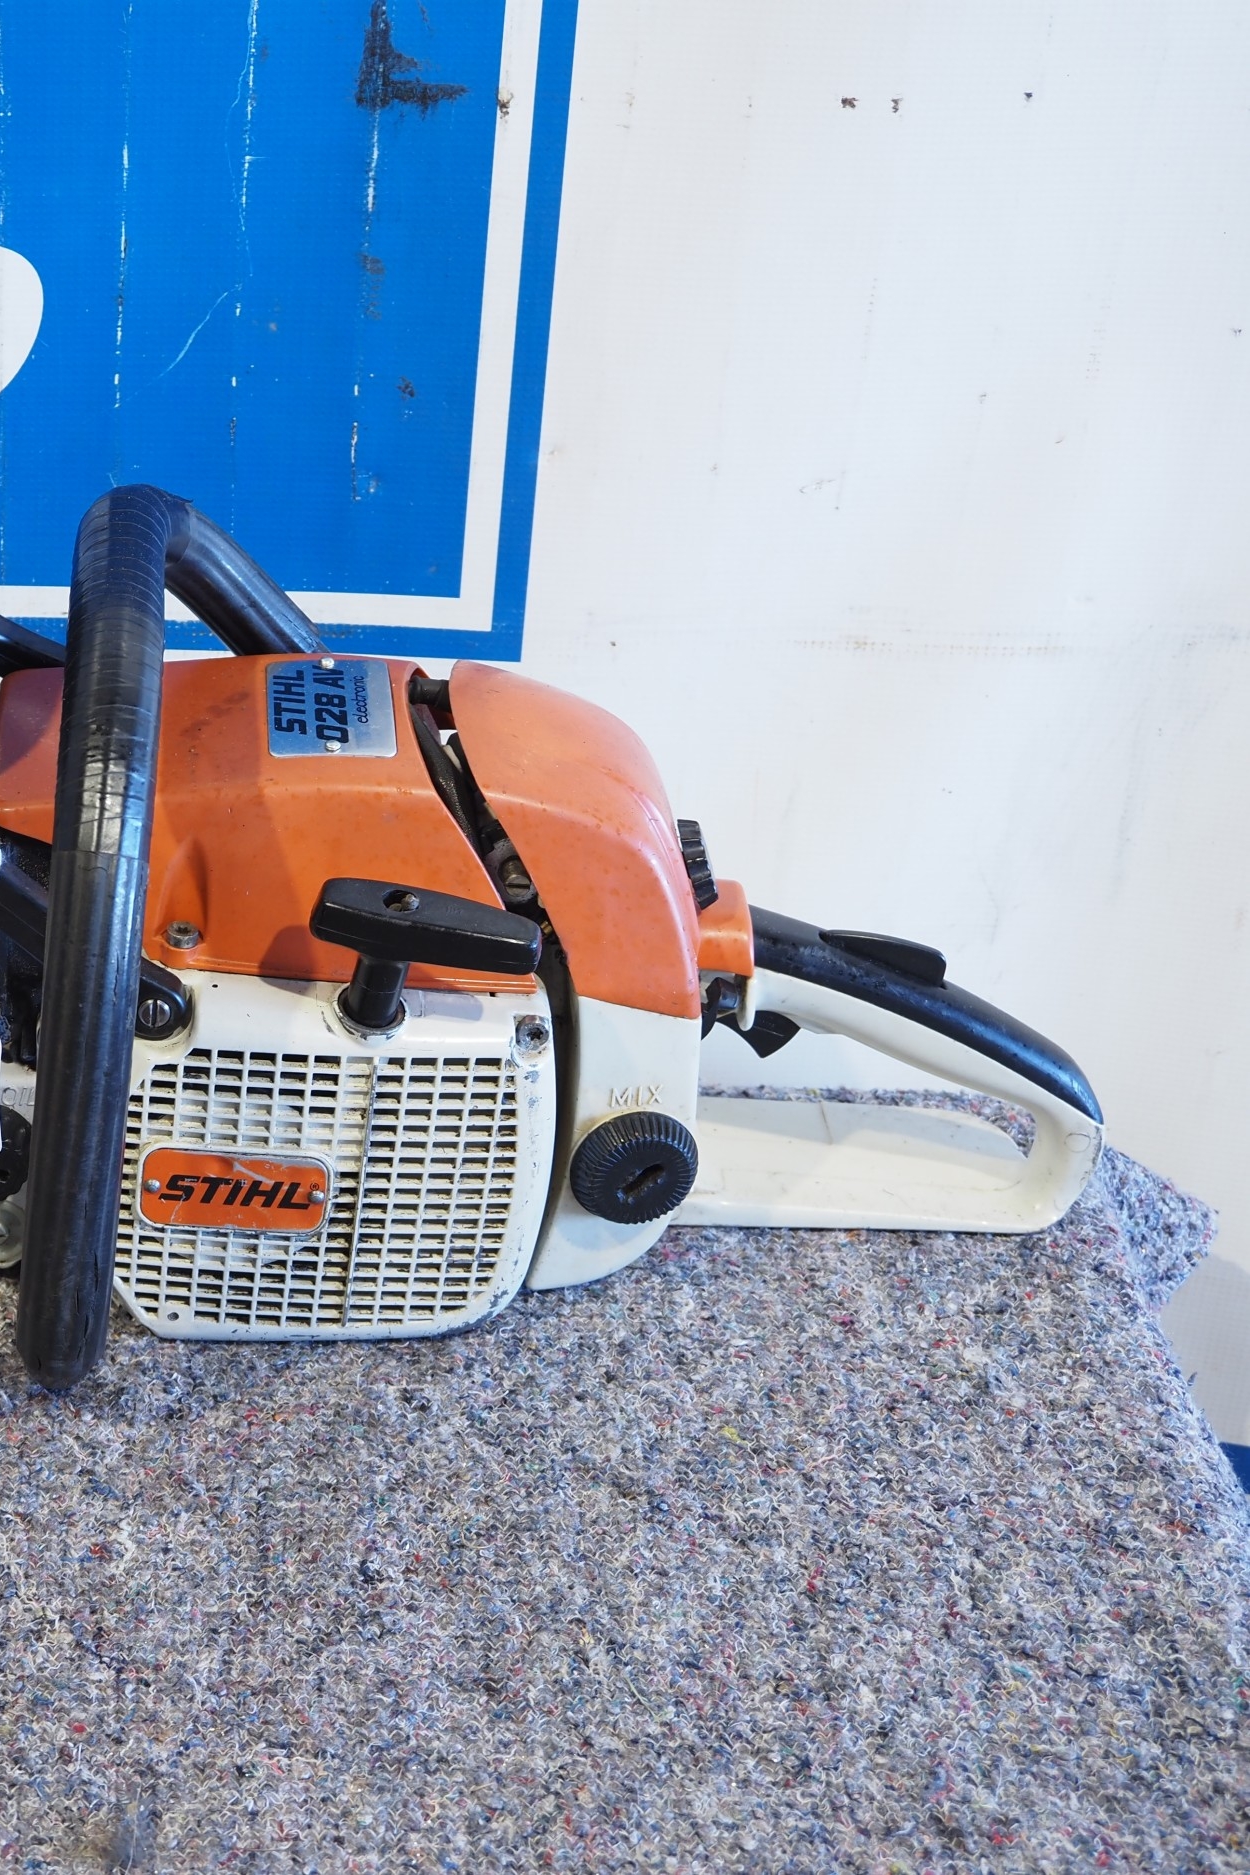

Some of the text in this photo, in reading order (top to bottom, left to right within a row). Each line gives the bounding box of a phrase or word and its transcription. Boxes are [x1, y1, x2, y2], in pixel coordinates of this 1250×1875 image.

[272, 669, 308, 736] STIHL
[313, 692, 350, 744] 028
[350, 675, 369, 724] electronic
[610, 1084, 664, 1108] MIX
[158, 1174, 312, 1210] STIHL
